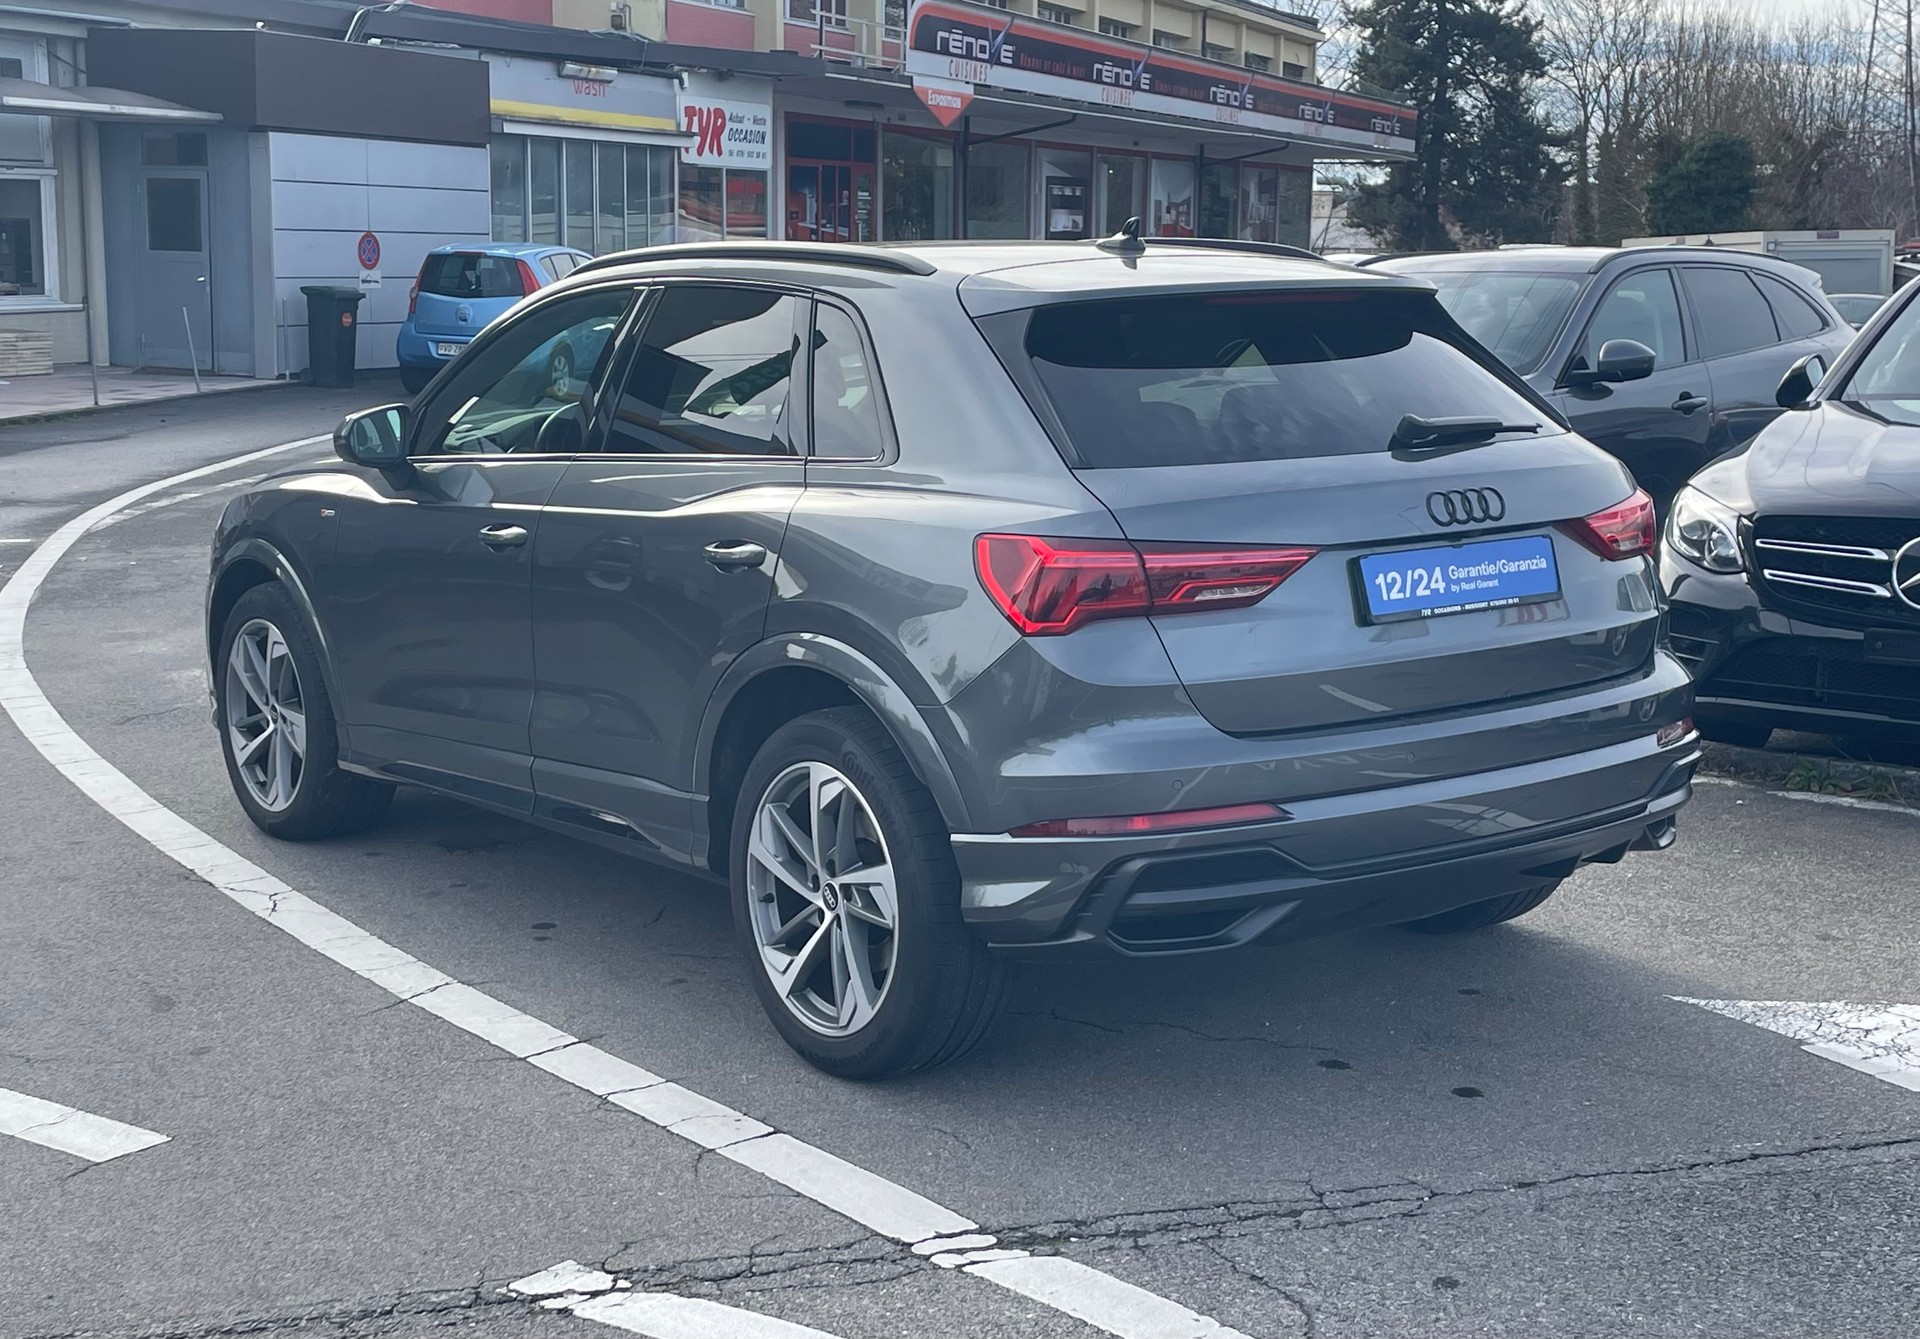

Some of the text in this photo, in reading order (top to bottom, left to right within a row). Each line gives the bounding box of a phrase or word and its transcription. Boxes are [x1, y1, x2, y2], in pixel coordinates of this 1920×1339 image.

[949, 59, 988, 82] CUISINES
[1101, 87, 1131, 106] CUISINES
[728, 112, 745, 123] Achat
[752, 115, 767, 126] Vente
[684, 106, 726, 157] TYR
[727, 128, 766, 144] OCCASION
[1448, 555, 1547, 579] Garantie/Garanzia
[1375, 566, 1446, 601] 12/24
[1450, 579, 1499, 593] by Real Garant
[1421, 608, 1432, 617] TYR
